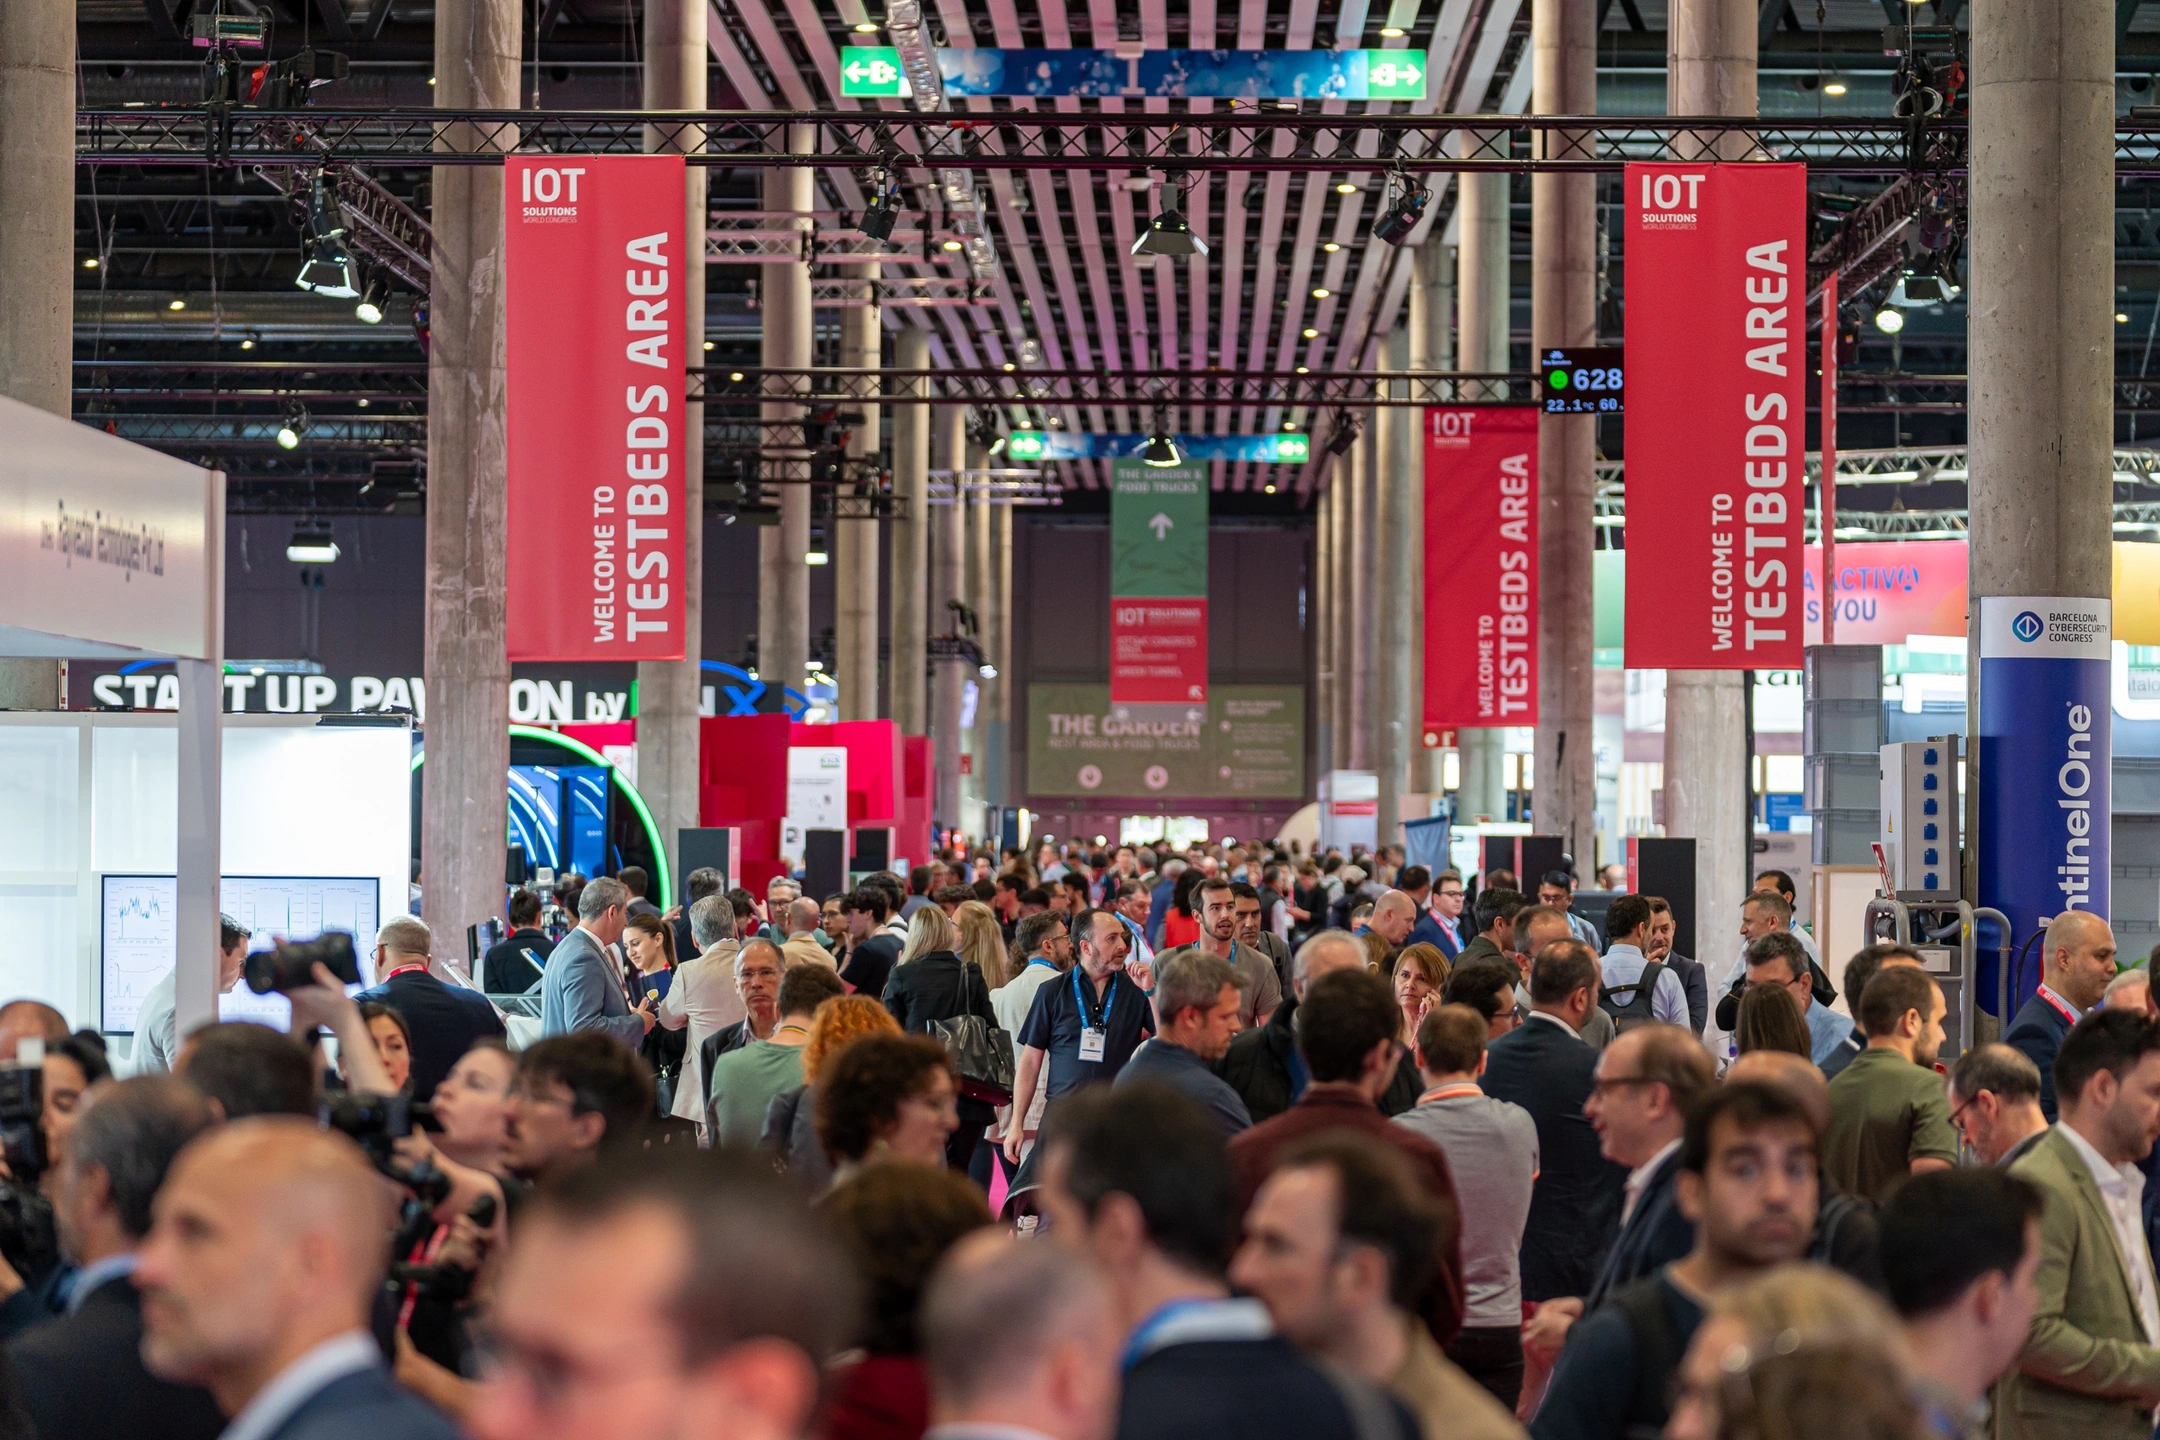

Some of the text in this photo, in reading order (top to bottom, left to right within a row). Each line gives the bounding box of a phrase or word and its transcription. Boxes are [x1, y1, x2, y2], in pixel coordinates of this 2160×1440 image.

[523, 168, 585, 203] IOT
[1642, 175, 1705, 209] IOT
[523, 207, 577, 216] SOLUTIONS
[1642, 214, 1697, 223] SOLUTIONS
[1572, 368, 1624, 391] 628
[626, 232, 669, 642] TESTBEDS AREA
[1433, 412, 1476, 436] IOT
[1745, 240, 1788, 650] TESTBEDS AREA
[593, 486, 615, 642] WELCOME TO
[1712, 494, 1733, 651] WELCOME TO
[1501, 453, 1529, 716] TESTBEDS AREA
[1117, 607, 1145, 626] IOT
[2049, 613, 2097, 622] BARCELONA
[2049, 623, 2107, 633] CYBERSECURITY
[2049, 633, 2093, 642] CONGRESS
[1478, 615, 1494, 717] WELCOME TO
[93, 674, 256, 714] STAT
[265, 675, 337, 714] UP
[351, 676, 573, 724] PAVON
[585, 691, 628, 724] by
[1049, 713, 1096, 735] THE
[2057, 704, 2091, 911] ntinelOne
